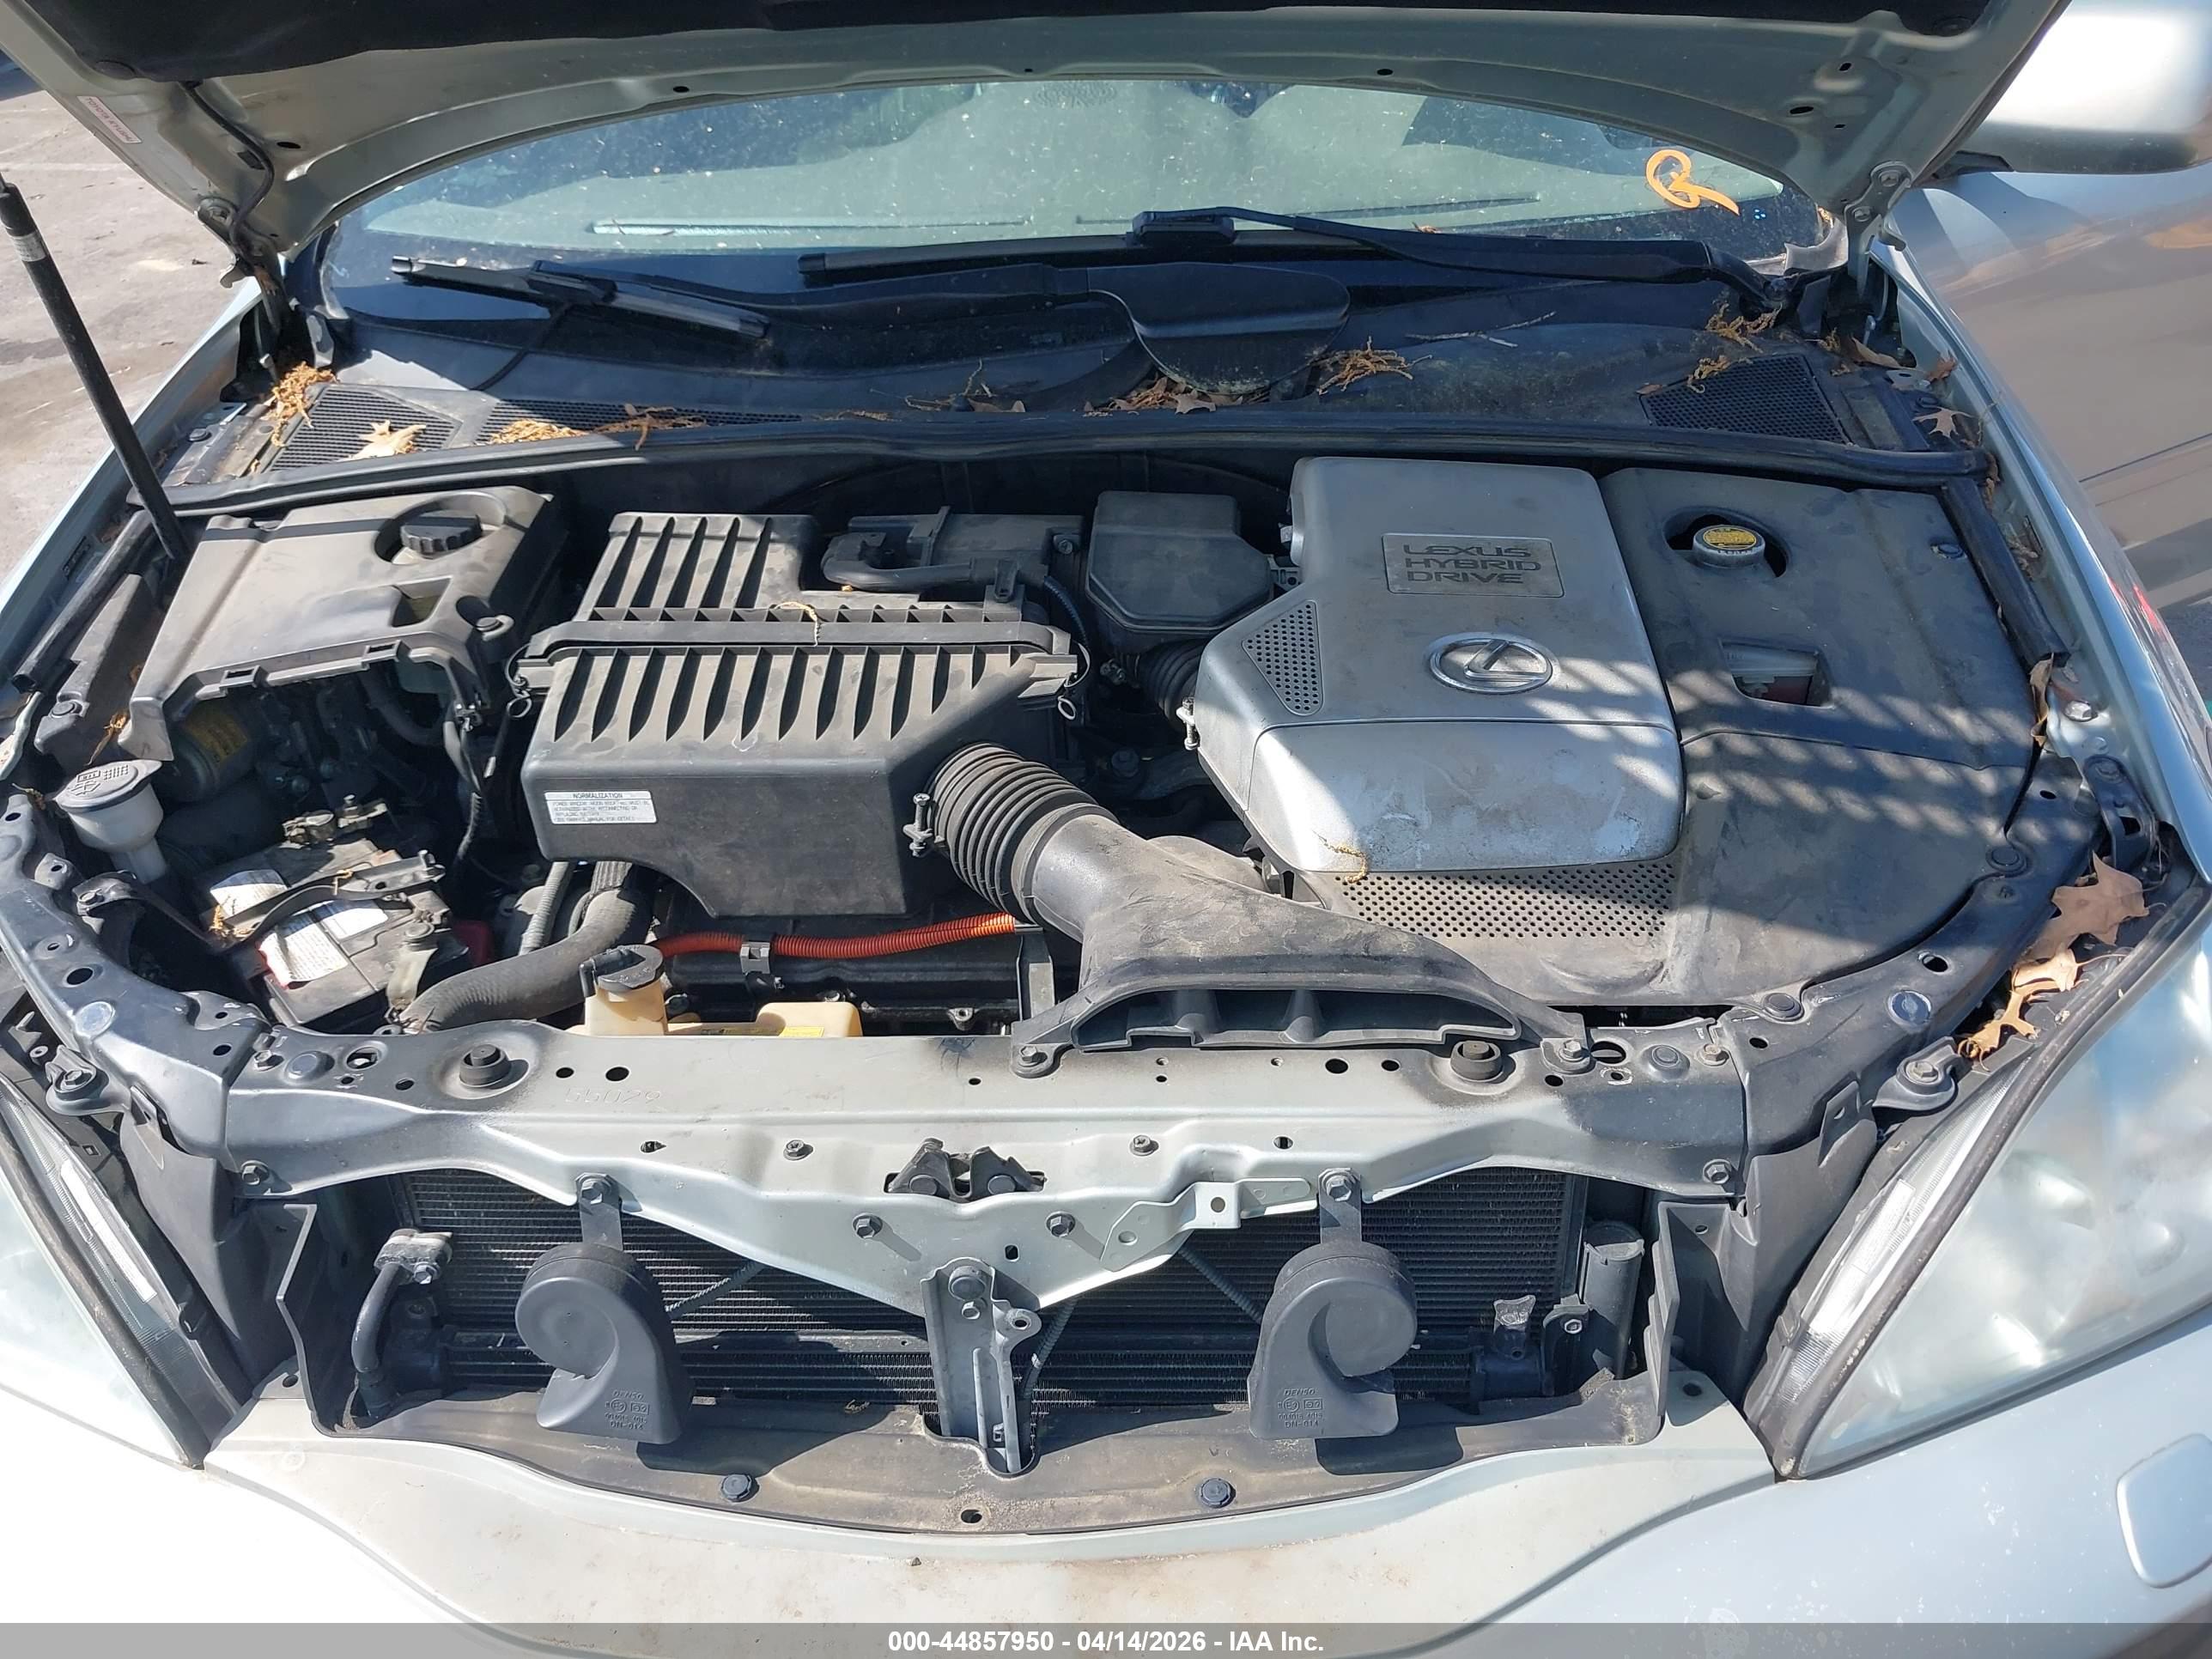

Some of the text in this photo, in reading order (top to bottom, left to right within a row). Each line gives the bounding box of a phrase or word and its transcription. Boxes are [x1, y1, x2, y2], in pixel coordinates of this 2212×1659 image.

[1403, 544, 1531, 557] LEXUS
[1406, 558, 1541, 571] HYBRID
[1407, 571, 1523, 584] DRIVE
